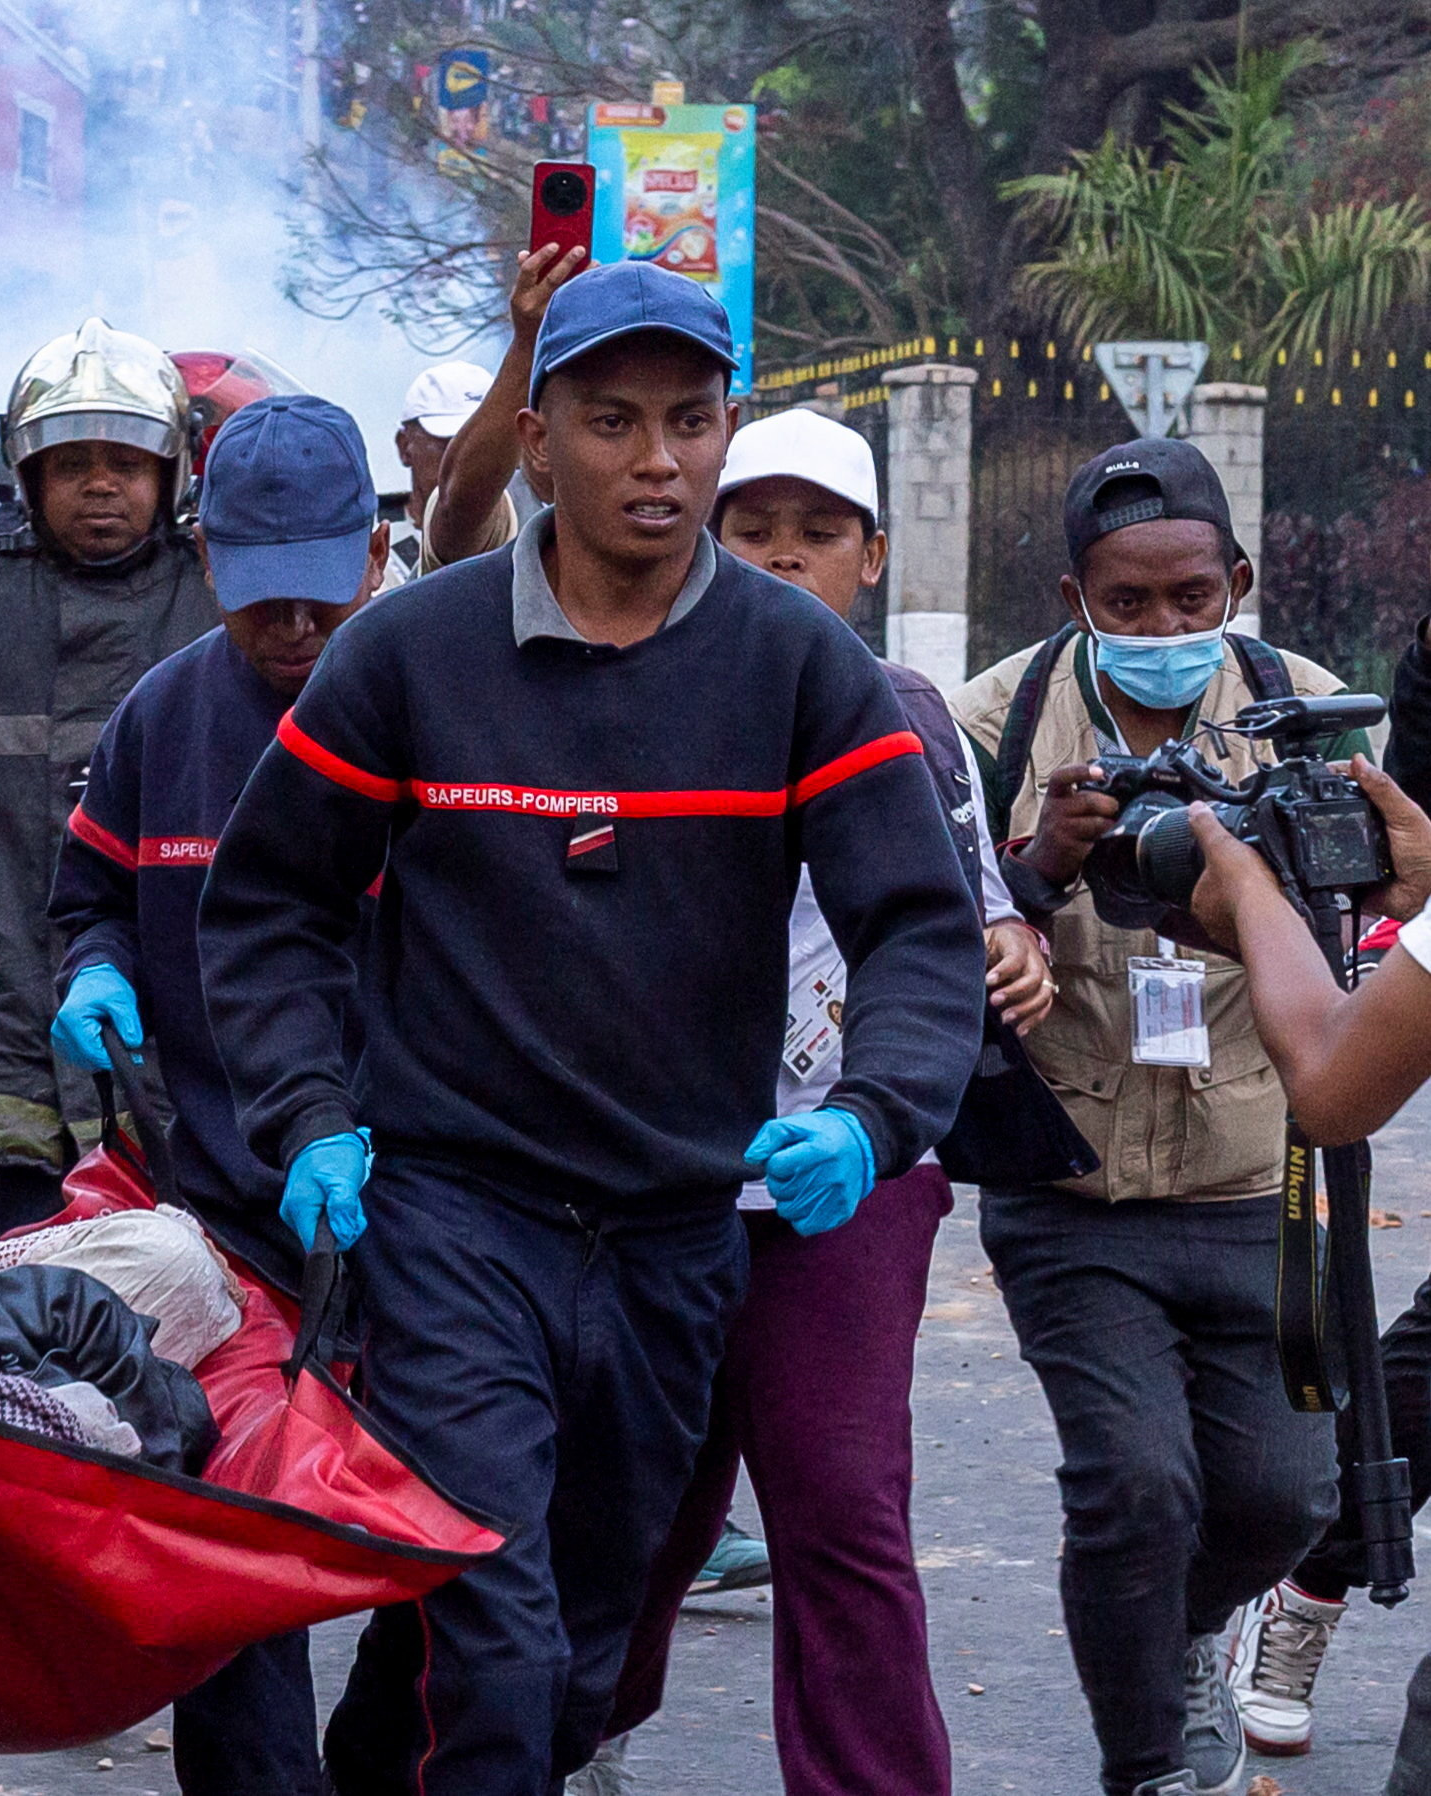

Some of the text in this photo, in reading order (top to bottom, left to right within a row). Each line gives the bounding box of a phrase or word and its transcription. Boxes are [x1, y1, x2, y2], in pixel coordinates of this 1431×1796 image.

[1105, 460, 1140, 473] BULLS
[426, 787, 619, 813] SAPEURS-POMPIERS
[1288, 1145, 1305, 1219] Nikon
